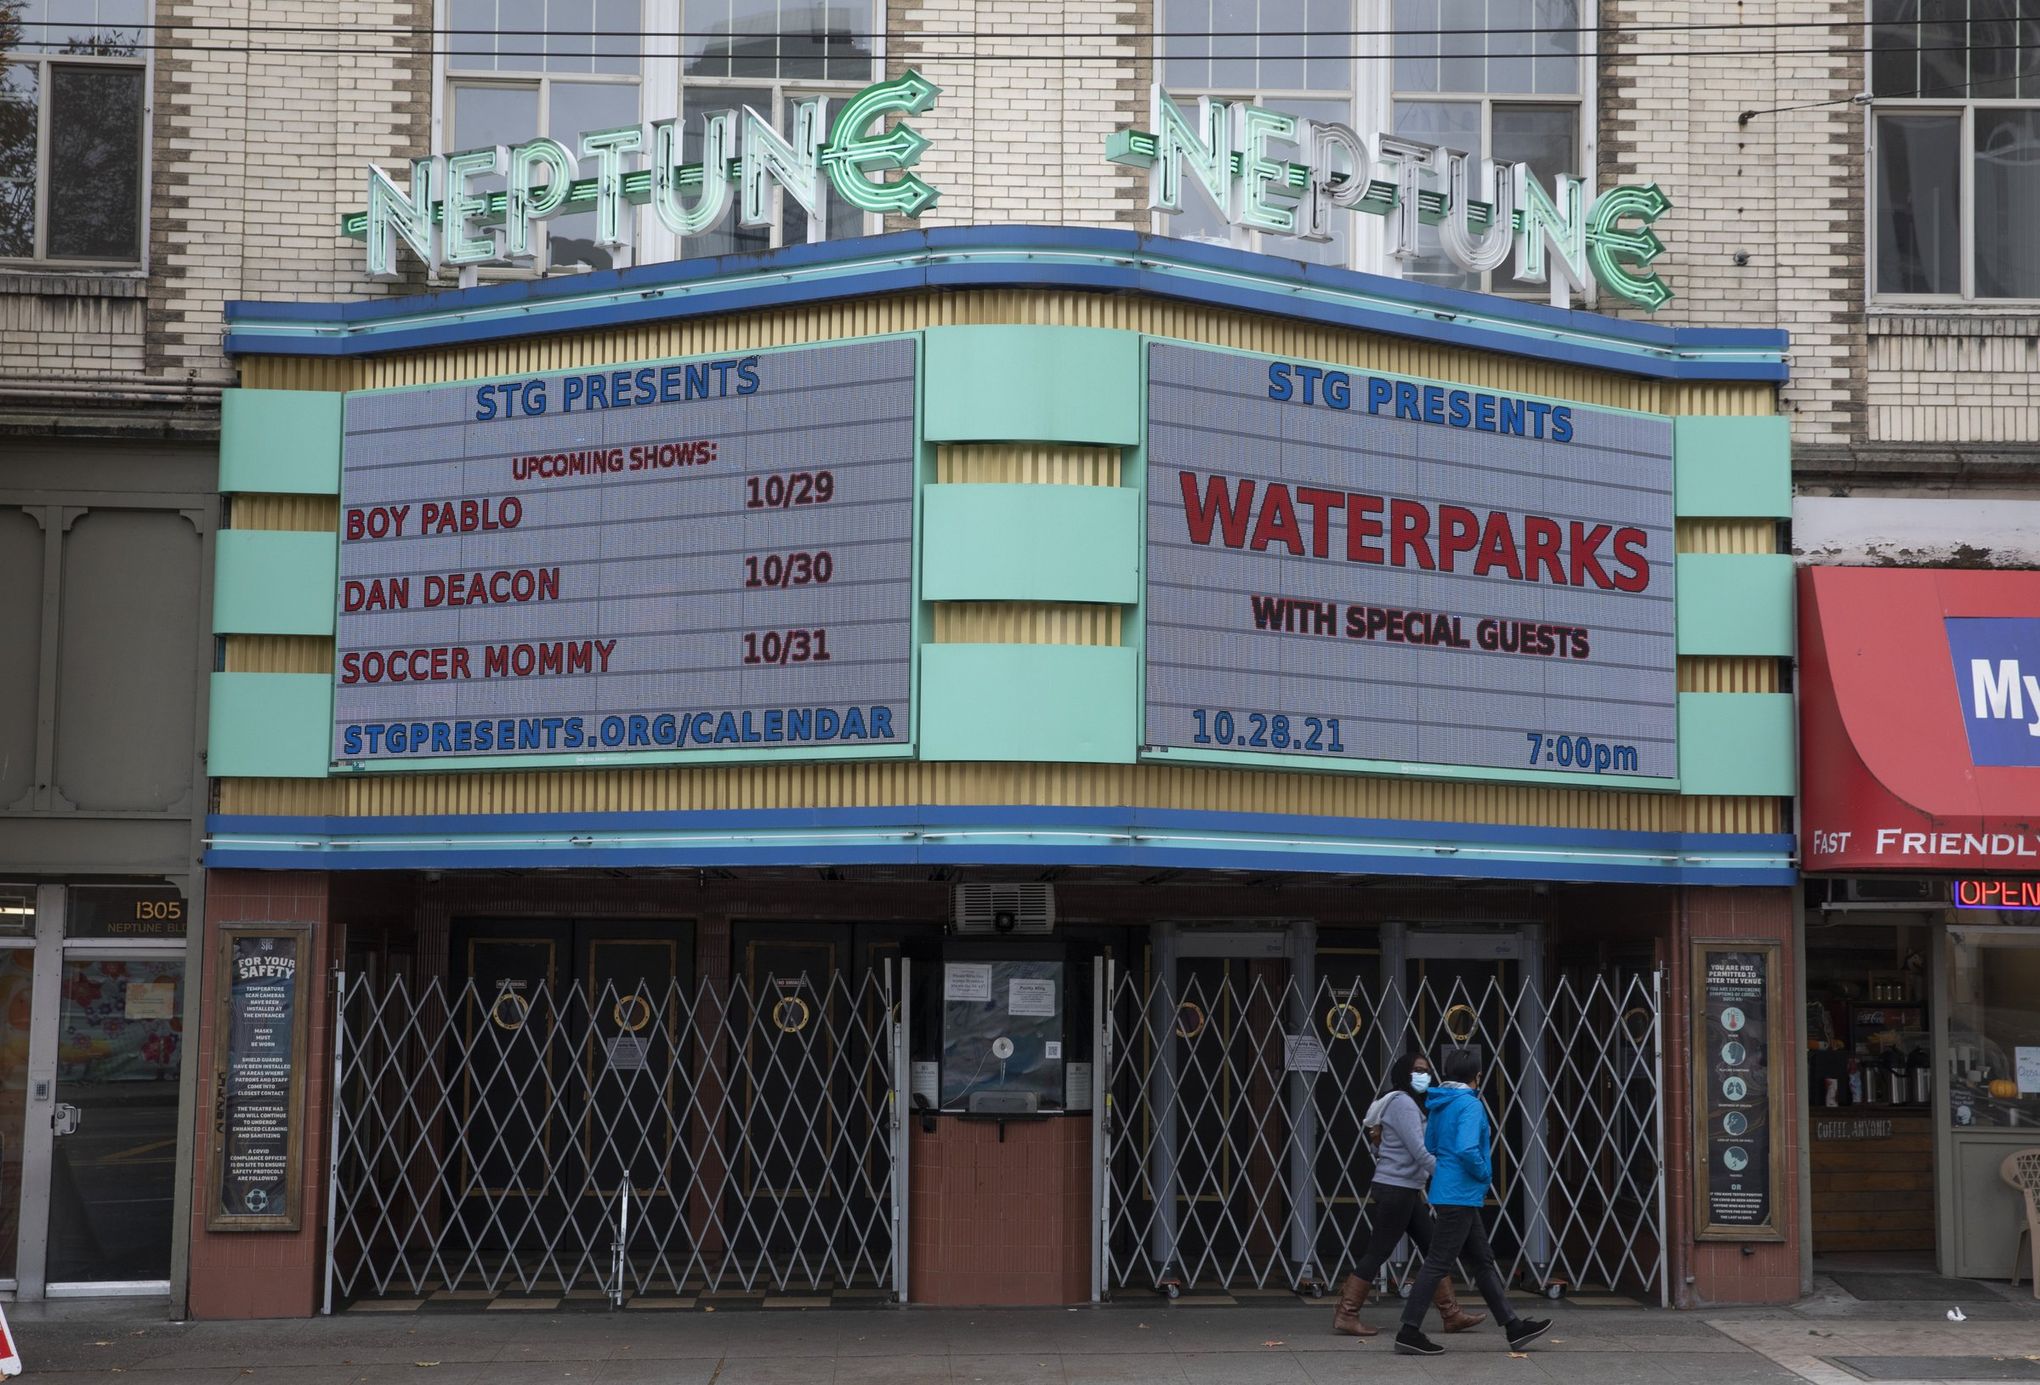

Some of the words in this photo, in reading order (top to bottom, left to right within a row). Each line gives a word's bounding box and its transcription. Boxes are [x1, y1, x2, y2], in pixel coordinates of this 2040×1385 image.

[365, 68, 944, 279] NEPTUNE
[1148, 83, 1675, 313] NEPTUNE
[476, 378, 547, 421] STG
[563, 357, 761, 413] PRESENTS
[1268, 361, 1350, 410] STG
[1368, 376, 1574, 443] PRESENTS
[512, 448, 624, 481] UPCOMING
[628, 440, 718, 472] SHOWS:
[747, 470, 834, 509] 10/29
[346, 505, 410, 540] BOY
[421, 496, 523, 535] PABLO
[1179, 470, 1650, 592] WATERPARKS
[344, 577, 409, 612] DAN
[423, 567, 560, 608] DEACON
[745, 551, 833, 589] 10/30
[743, 629, 830, 665] 10/31
[1250, 595, 1338, 637] WITH
[1345, 605, 1471, 649] SPECIAL
[1476, 620, 1590, 659] GUESTS
[342, 647, 471, 684] SOCCER
[484, 639, 617, 678] MOMMY
[344, 705, 895, 755] STGPRESENTS.ORG/CALENDAR
[1192, 708, 1344, 752] 10.28.21
[1527, 733, 1639, 771] 7:00pm
[1813, 829, 1852, 856] FAST
[1875, 828, 2040, 856] FRIENDL
[136, 901, 181, 919] 1305
[1960, 881, 2040, 906] OPEN
[107, 923, 162, 933] NEPTUNE
[238, 957, 261, 968] FOR
[264, 957, 295, 968] YOUR
[240, 966, 294, 979] SAFETY
